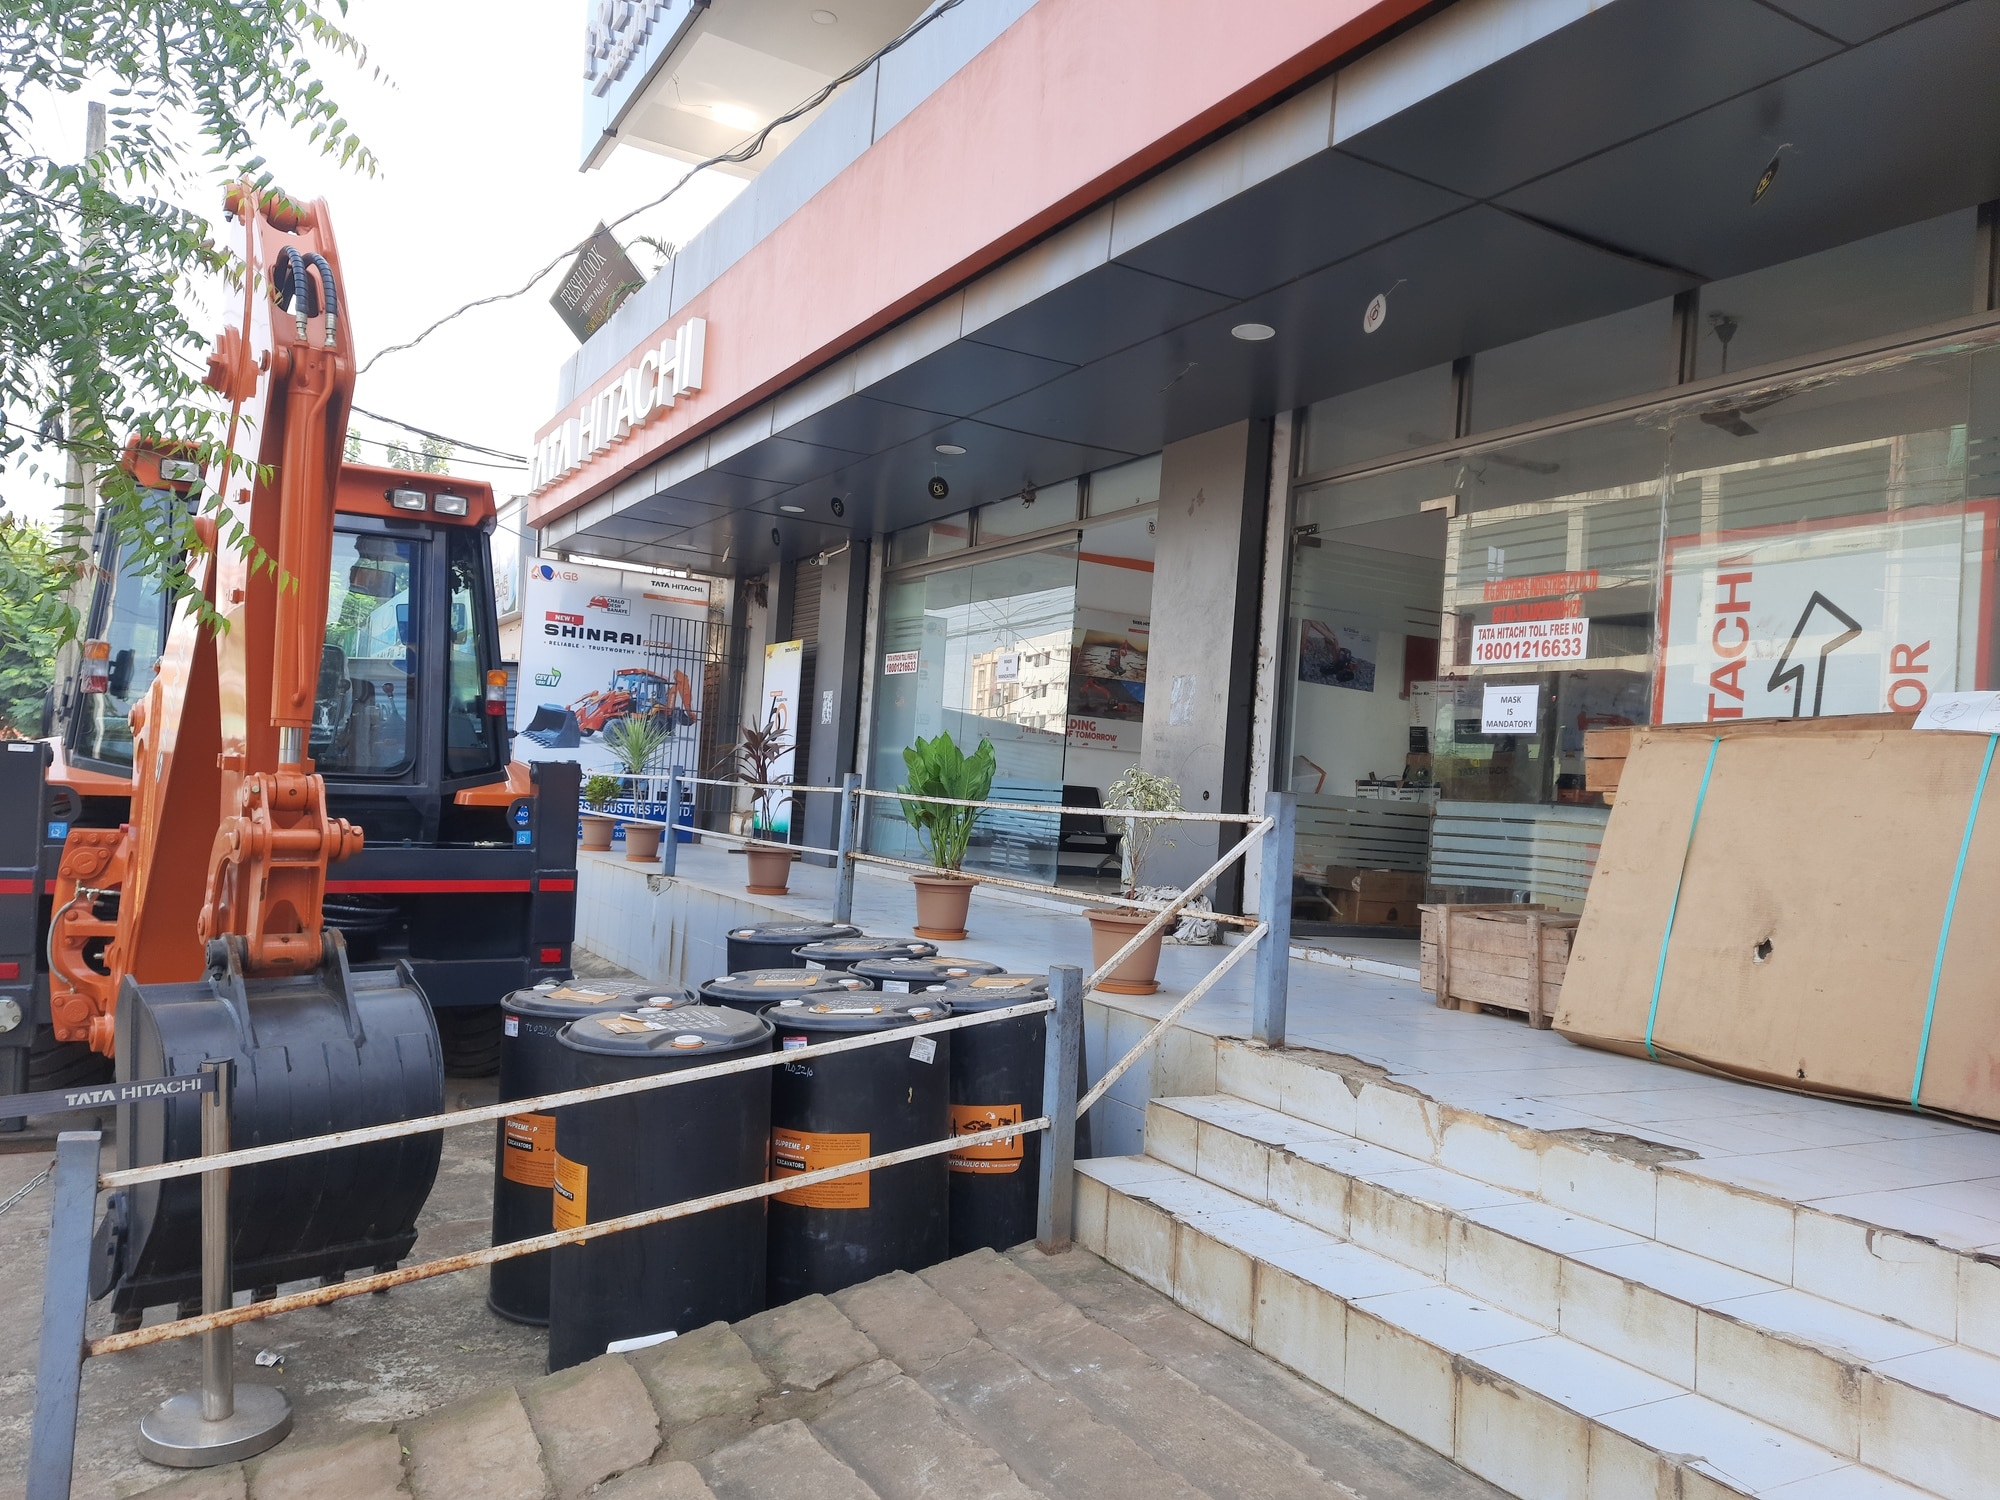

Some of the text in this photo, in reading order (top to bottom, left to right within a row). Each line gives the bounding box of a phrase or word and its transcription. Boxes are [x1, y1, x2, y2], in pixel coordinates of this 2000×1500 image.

[560, 244, 607, 310] FRESH LOOK
[582, 278, 608, 313] BEAUTY PALACE
[578, 317, 706, 463] HITACHI
[651, 580, 703, 593] TATA HITACHI
[544, 623, 642, 646] SHINRAI
[1478, 622, 1583, 640] TATA HITACHI TOLL FREE NO
[549, 640, 580, 649] RELIABLE
[589, 645, 635, 655] TRUSTWORTHY
[1476, 637, 1582, 660] 18001216633
[1500, 696, 1521, 704] MASK
[1068, 719, 1097, 731] DING
[1486, 720, 1532, 728] MANDATORY
[1075, 731, 1117, 741] TOMORROW
[65, 1078, 202, 1106] TATA HITACHI
[507, 1120, 529, 1132] SUPREME
[507, 1139, 532, 1150] EXCAVATORS
[775, 1139, 801, 1150] SUPREME
[776, 1158, 805, 1169] EXCAVATORS
